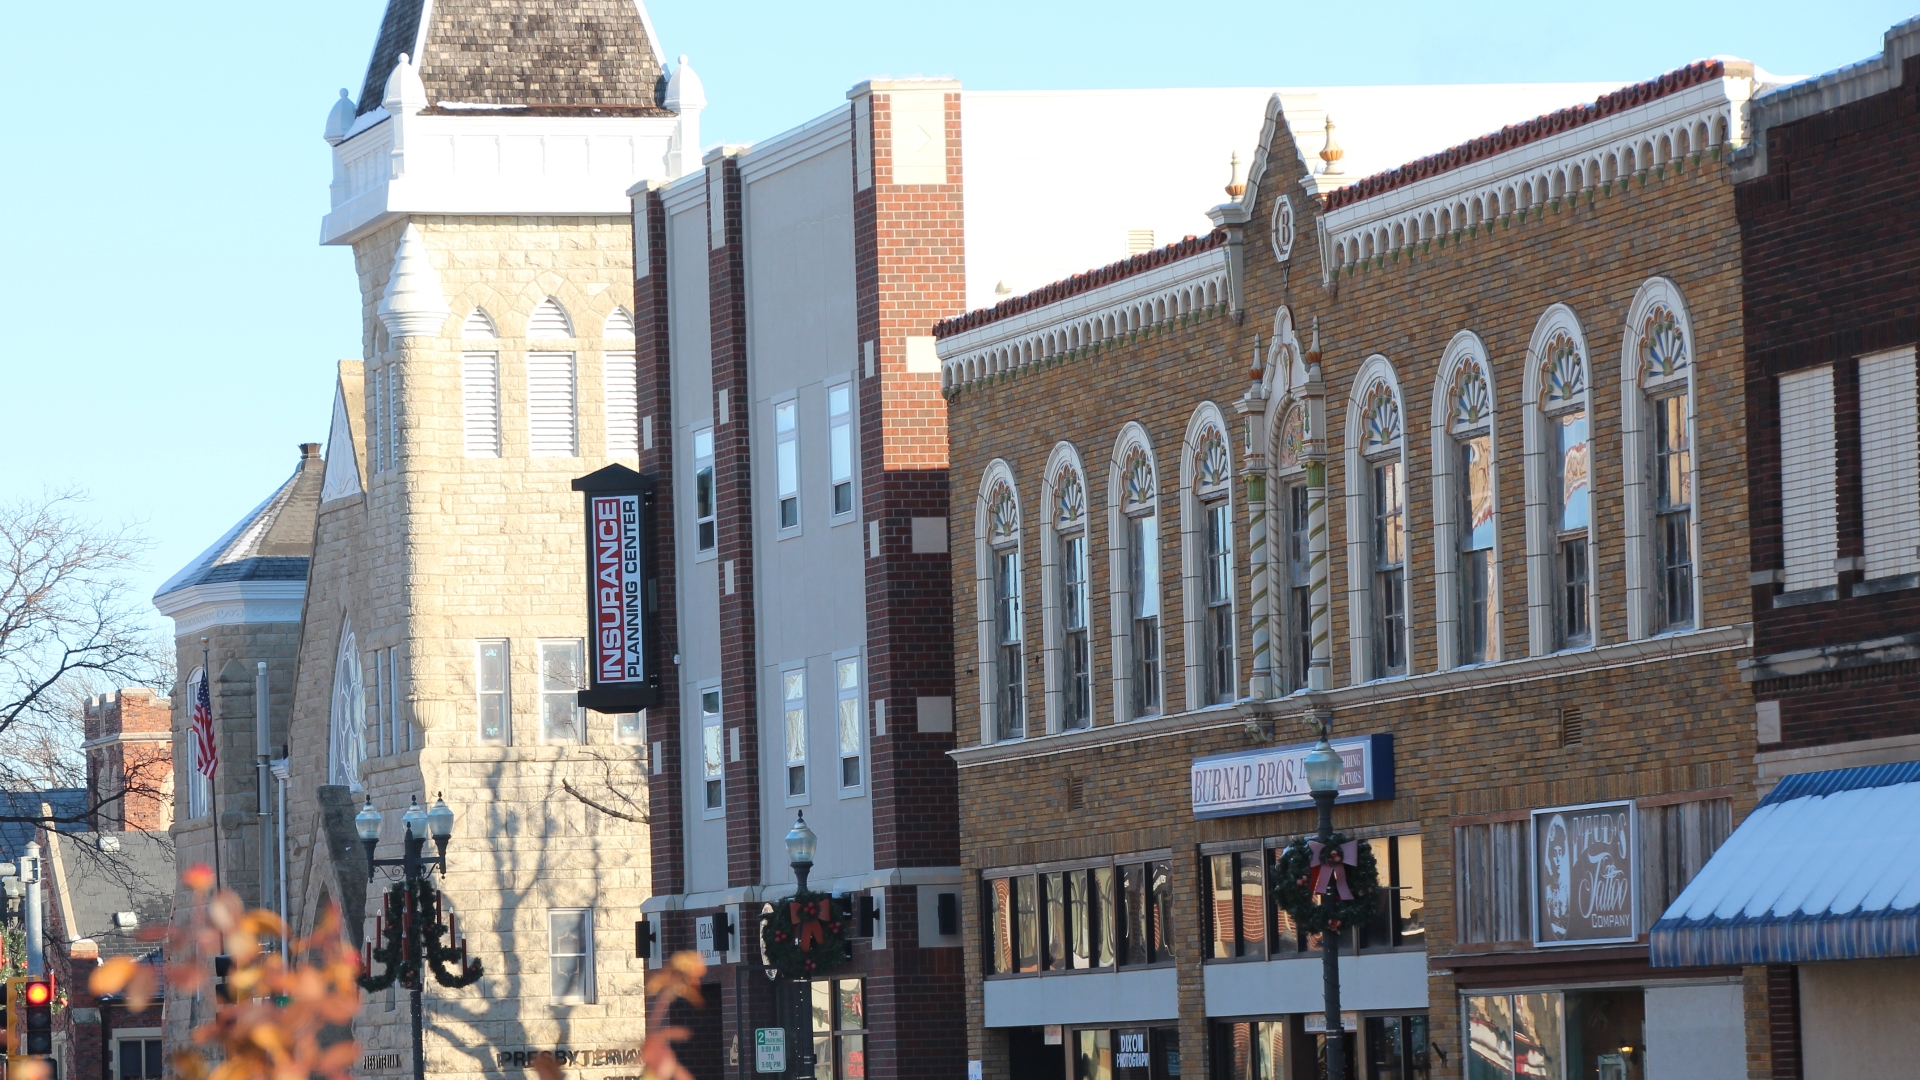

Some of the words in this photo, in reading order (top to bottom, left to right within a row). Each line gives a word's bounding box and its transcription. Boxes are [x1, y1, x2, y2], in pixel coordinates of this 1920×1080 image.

[1281, 211, 1290, 246] B
[622, 500, 638, 574] CENTER
[598, 501, 622, 679] INSURANCE
[625, 580, 641, 678] PLANNING
[1194, 765, 1251, 803] BURNAP
[1256, 759, 1297, 797] BROS.
[1579, 852, 1628, 919] Tattoo
[1591, 914, 1630, 929] COMPANY
[757, 1031, 765, 1043] 2
[1120, 1034, 1144, 1053] DIXON
